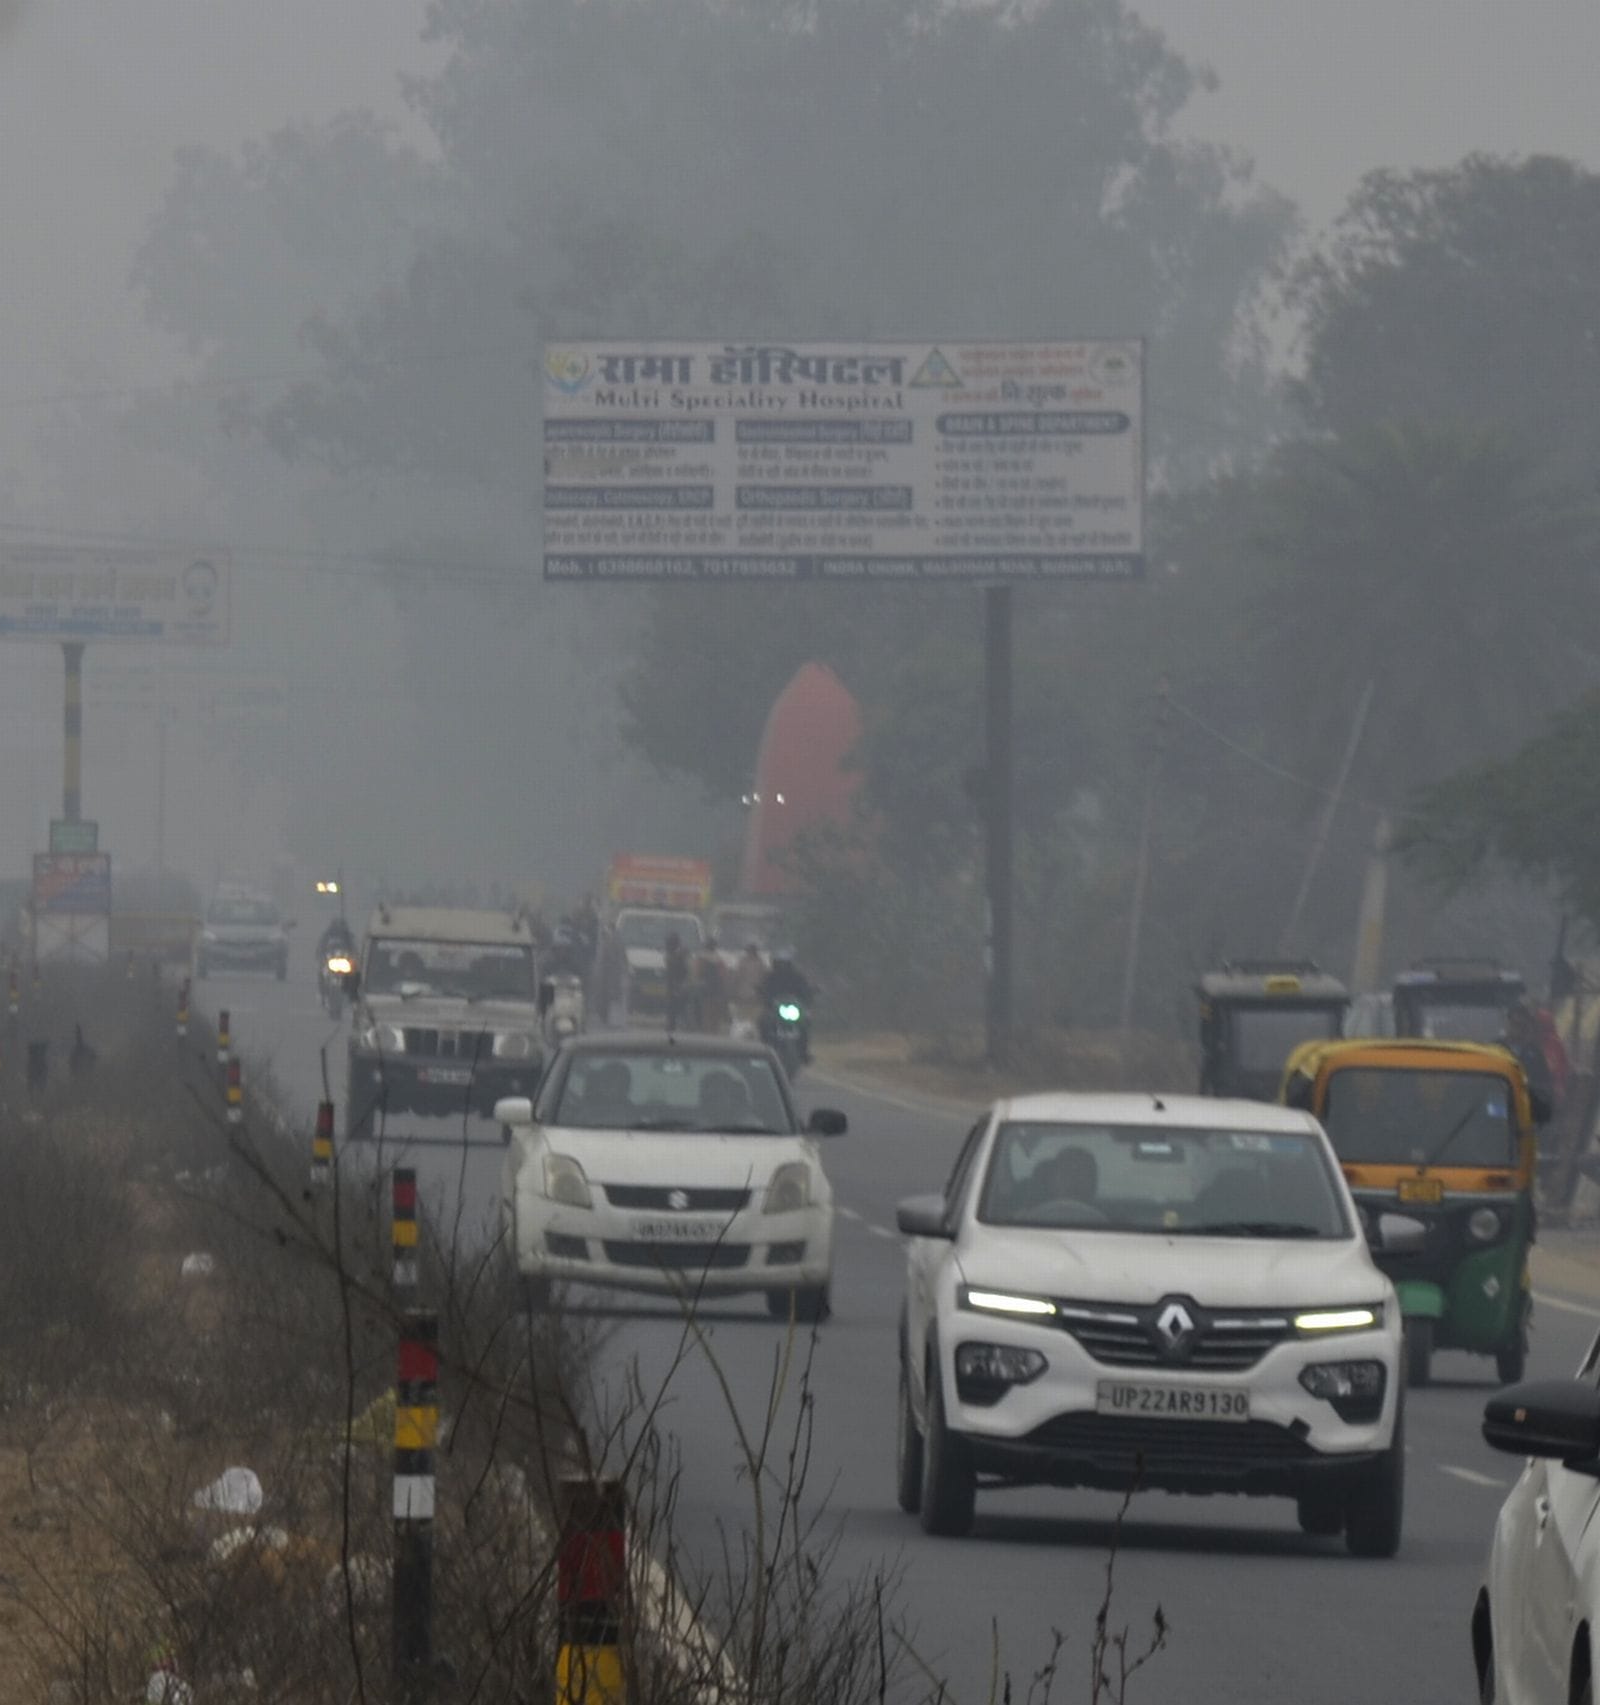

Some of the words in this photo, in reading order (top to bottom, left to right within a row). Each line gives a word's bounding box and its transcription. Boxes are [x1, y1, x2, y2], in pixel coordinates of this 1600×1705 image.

[596, 353, 695, 385] रामा
[707, 345, 908, 385] हॉस्पिटल
[595, 389, 660, 409] Multi
[670, 390, 788, 412] Speciality
[799, 390, 904, 411] Hospital
[1111, 1386, 1247, 1415] UP22AR9130
